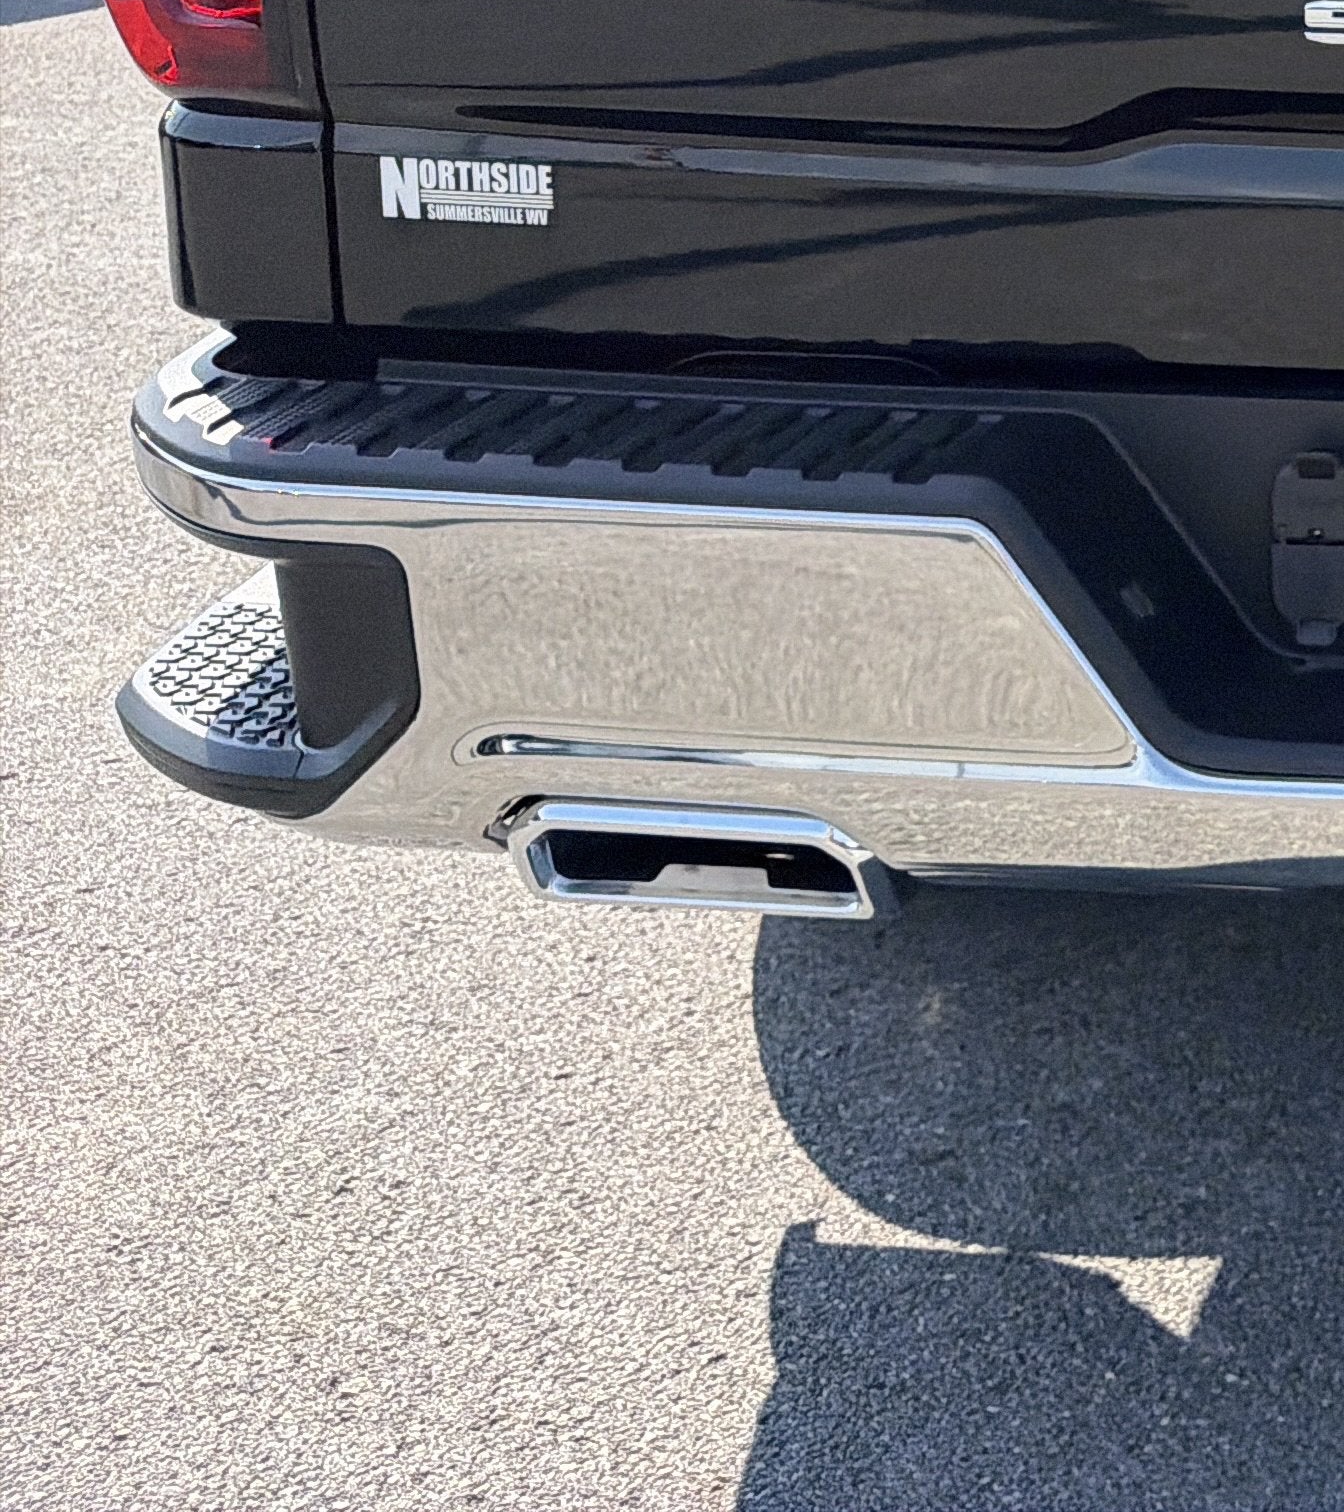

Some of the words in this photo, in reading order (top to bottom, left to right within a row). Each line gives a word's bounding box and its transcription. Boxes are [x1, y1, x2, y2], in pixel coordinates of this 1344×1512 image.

[379, 156, 553, 220] NORTHSIDE
[427, 204, 524, 223] SUMMERSVILLE
[525, 209, 548, 226] WV
